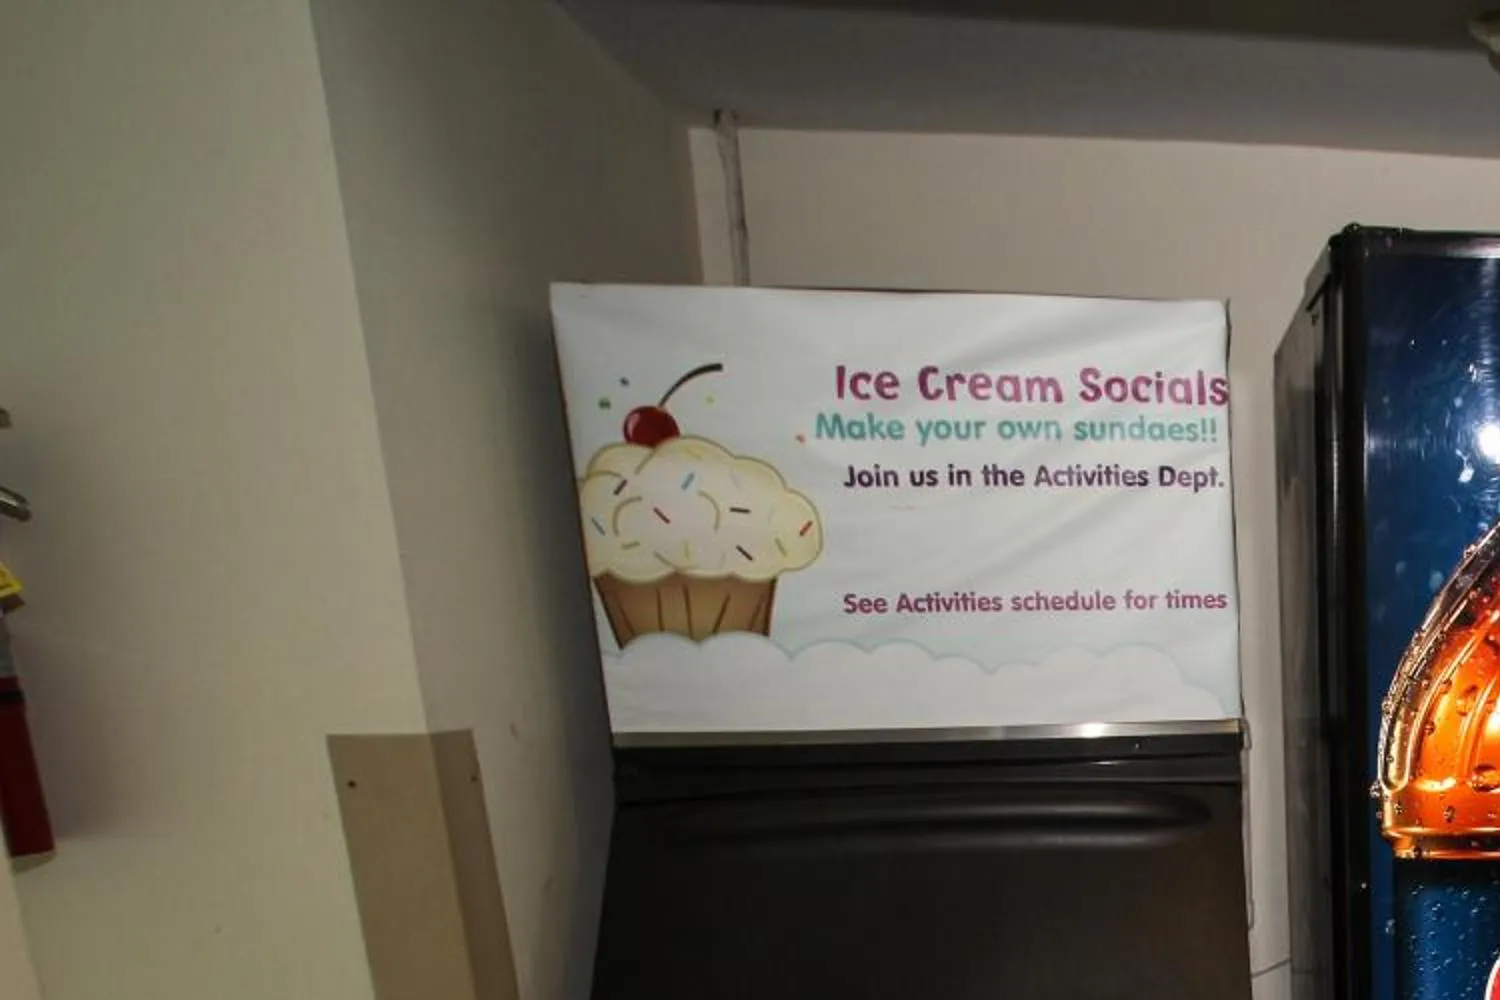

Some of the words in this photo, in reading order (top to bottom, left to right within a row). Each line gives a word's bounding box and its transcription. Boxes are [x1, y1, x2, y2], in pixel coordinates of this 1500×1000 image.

[835, 364, 901, 401] Ice
[917, 365, 1064, 404] Cream
[1079, 366, 1230, 406] Socials
[815, 412, 905, 441] Make
[915, 416, 987, 447] your
[998, 418, 1063, 441] own
[1073, 415, 1219, 443] sundaes!!
[843, 463, 899, 488] Join
[909, 469, 938, 488] us
[947, 463, 973, 487] in
[982, 463, 1026, 488] the
[1034, 463, 1150, 488] Activities
[1158, 464, 1225, 493] Dept.
[843, 592, 889, 614] See
[896, 590, 1004, 614] Activities
[1010, 589, 1116, 612] schedule
[1123, 589, 1156, 610] for
[1165, 588, 1228, 609] times
